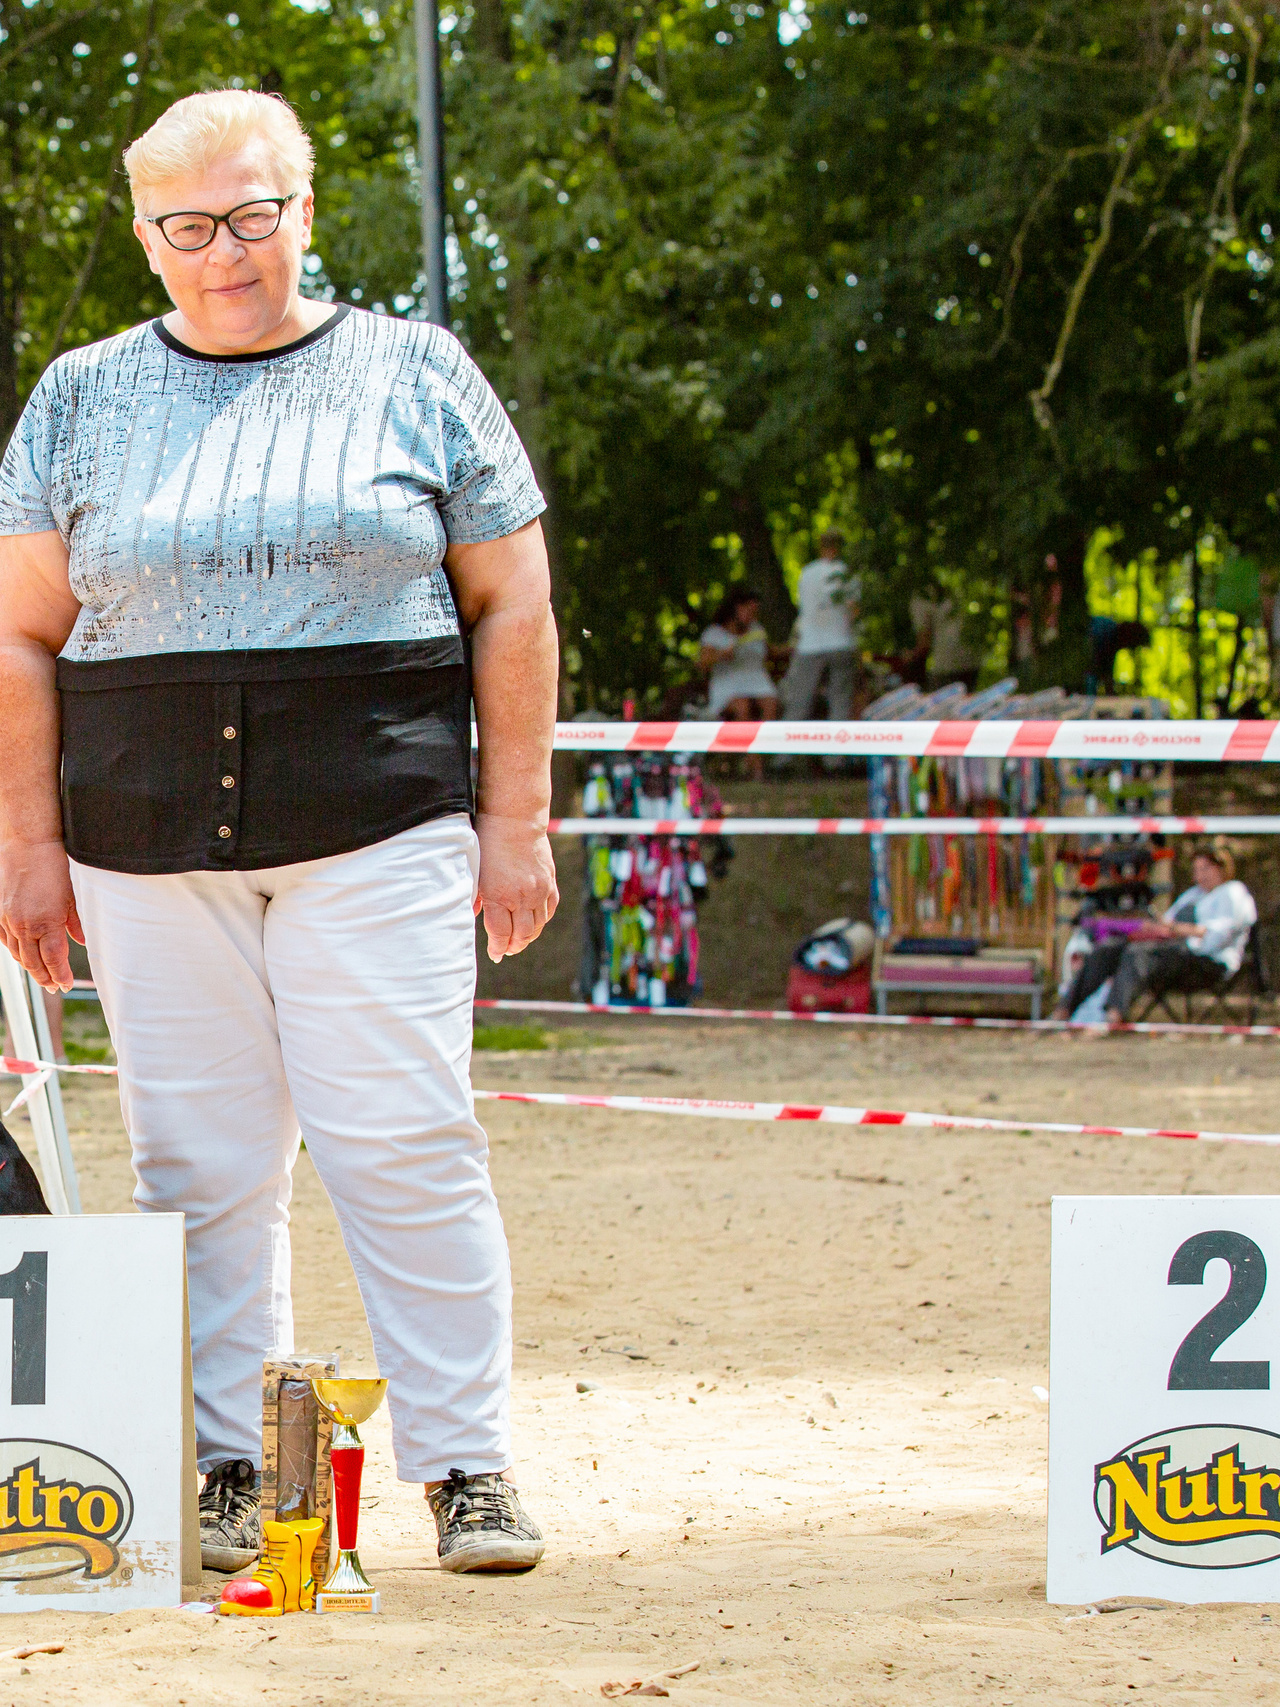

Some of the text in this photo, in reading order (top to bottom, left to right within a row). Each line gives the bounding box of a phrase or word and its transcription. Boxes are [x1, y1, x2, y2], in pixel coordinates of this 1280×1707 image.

[784, 732, 904, 743] ВОСТОК СЕРВИС
[1082, 734, 1202, 745] ВОСТОК СЕРВИС
[1166, 1229, 1271, 1391] 2
[1097, 1446, 1280, 1552] Nutr
